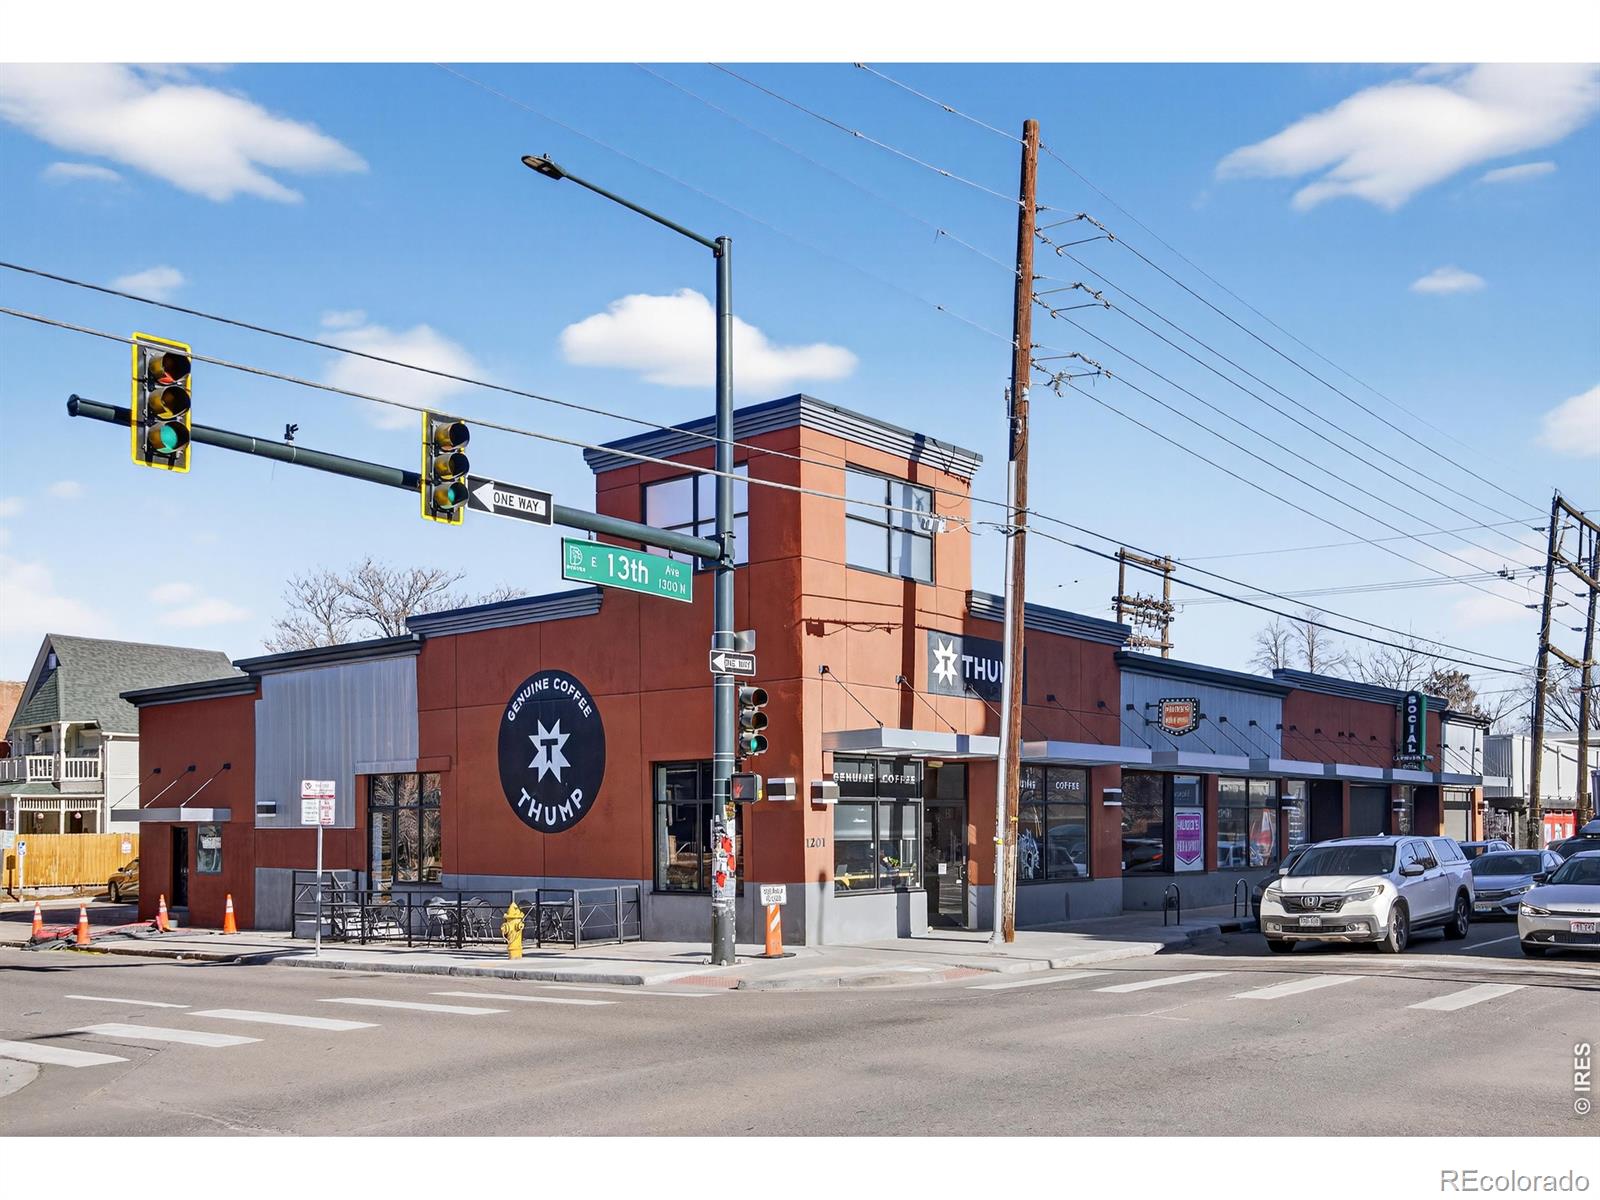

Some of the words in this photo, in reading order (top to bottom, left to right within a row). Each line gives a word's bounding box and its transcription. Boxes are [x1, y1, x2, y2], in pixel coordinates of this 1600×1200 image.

[493, 491, 514, 507] ONE
[518, 497, 539, 512] WAY
[591, 556, 598, 568] E
[607, 553, 649, 584] 13th
[665, 565, 680, 577] Ave
[658, 578, 678, 592] 1300
[680, 583, 686, 594] N
[961, 654, 1004, 684] THU
[507, 678, 549, 721] GENUINE
[553, 678, 592, 718] COFFEE
[1407, 695, 1417, 753] SOCIAL
[833, 772, 874, 783] GENUINE
[881, 774, 916, 785] COFFEE
[1055, 781, 1080, 790] COFFEE
[517, 787, 583, 826] THUMP
[806, 837, 825, 848] 1201
